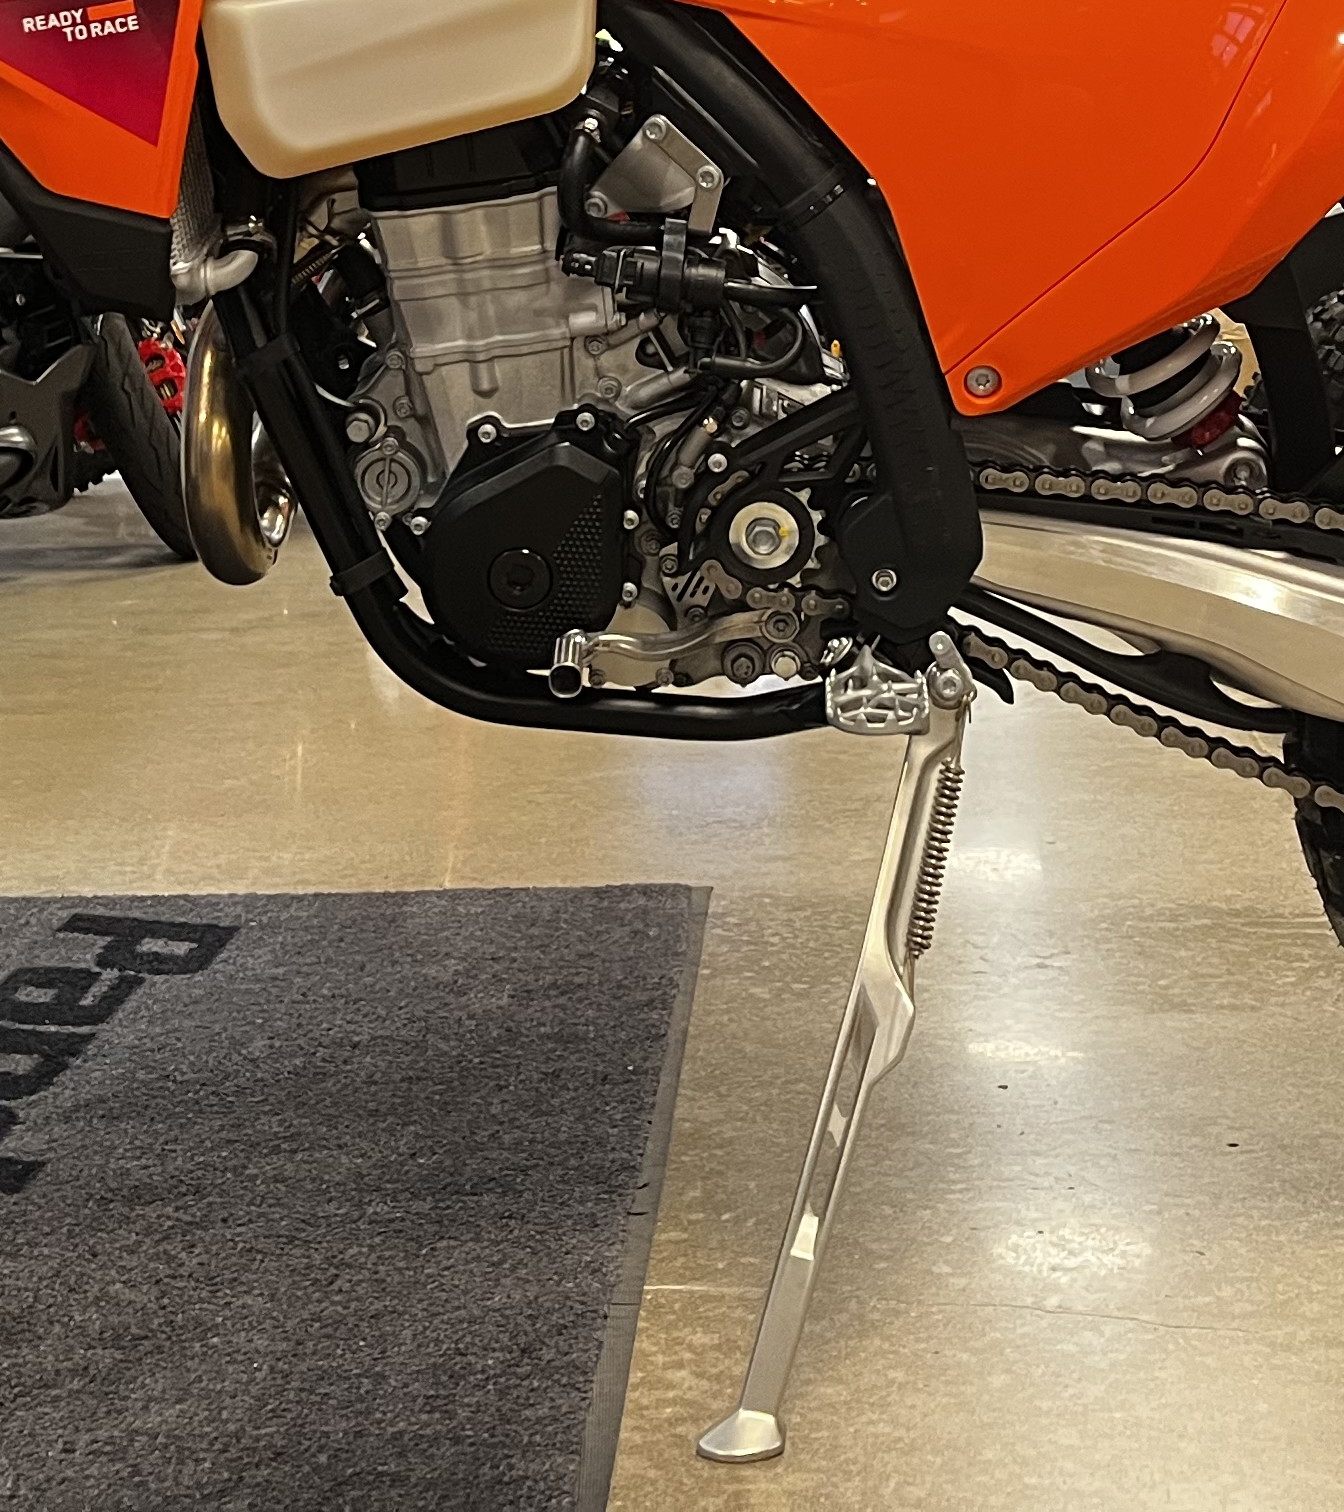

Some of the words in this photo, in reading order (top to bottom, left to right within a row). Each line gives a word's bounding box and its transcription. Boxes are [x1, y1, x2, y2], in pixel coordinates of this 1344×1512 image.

[22, 8, 84, 33] READY
[62, 24, 88, 42] TO
[89, 15, 140, 38] RACE
